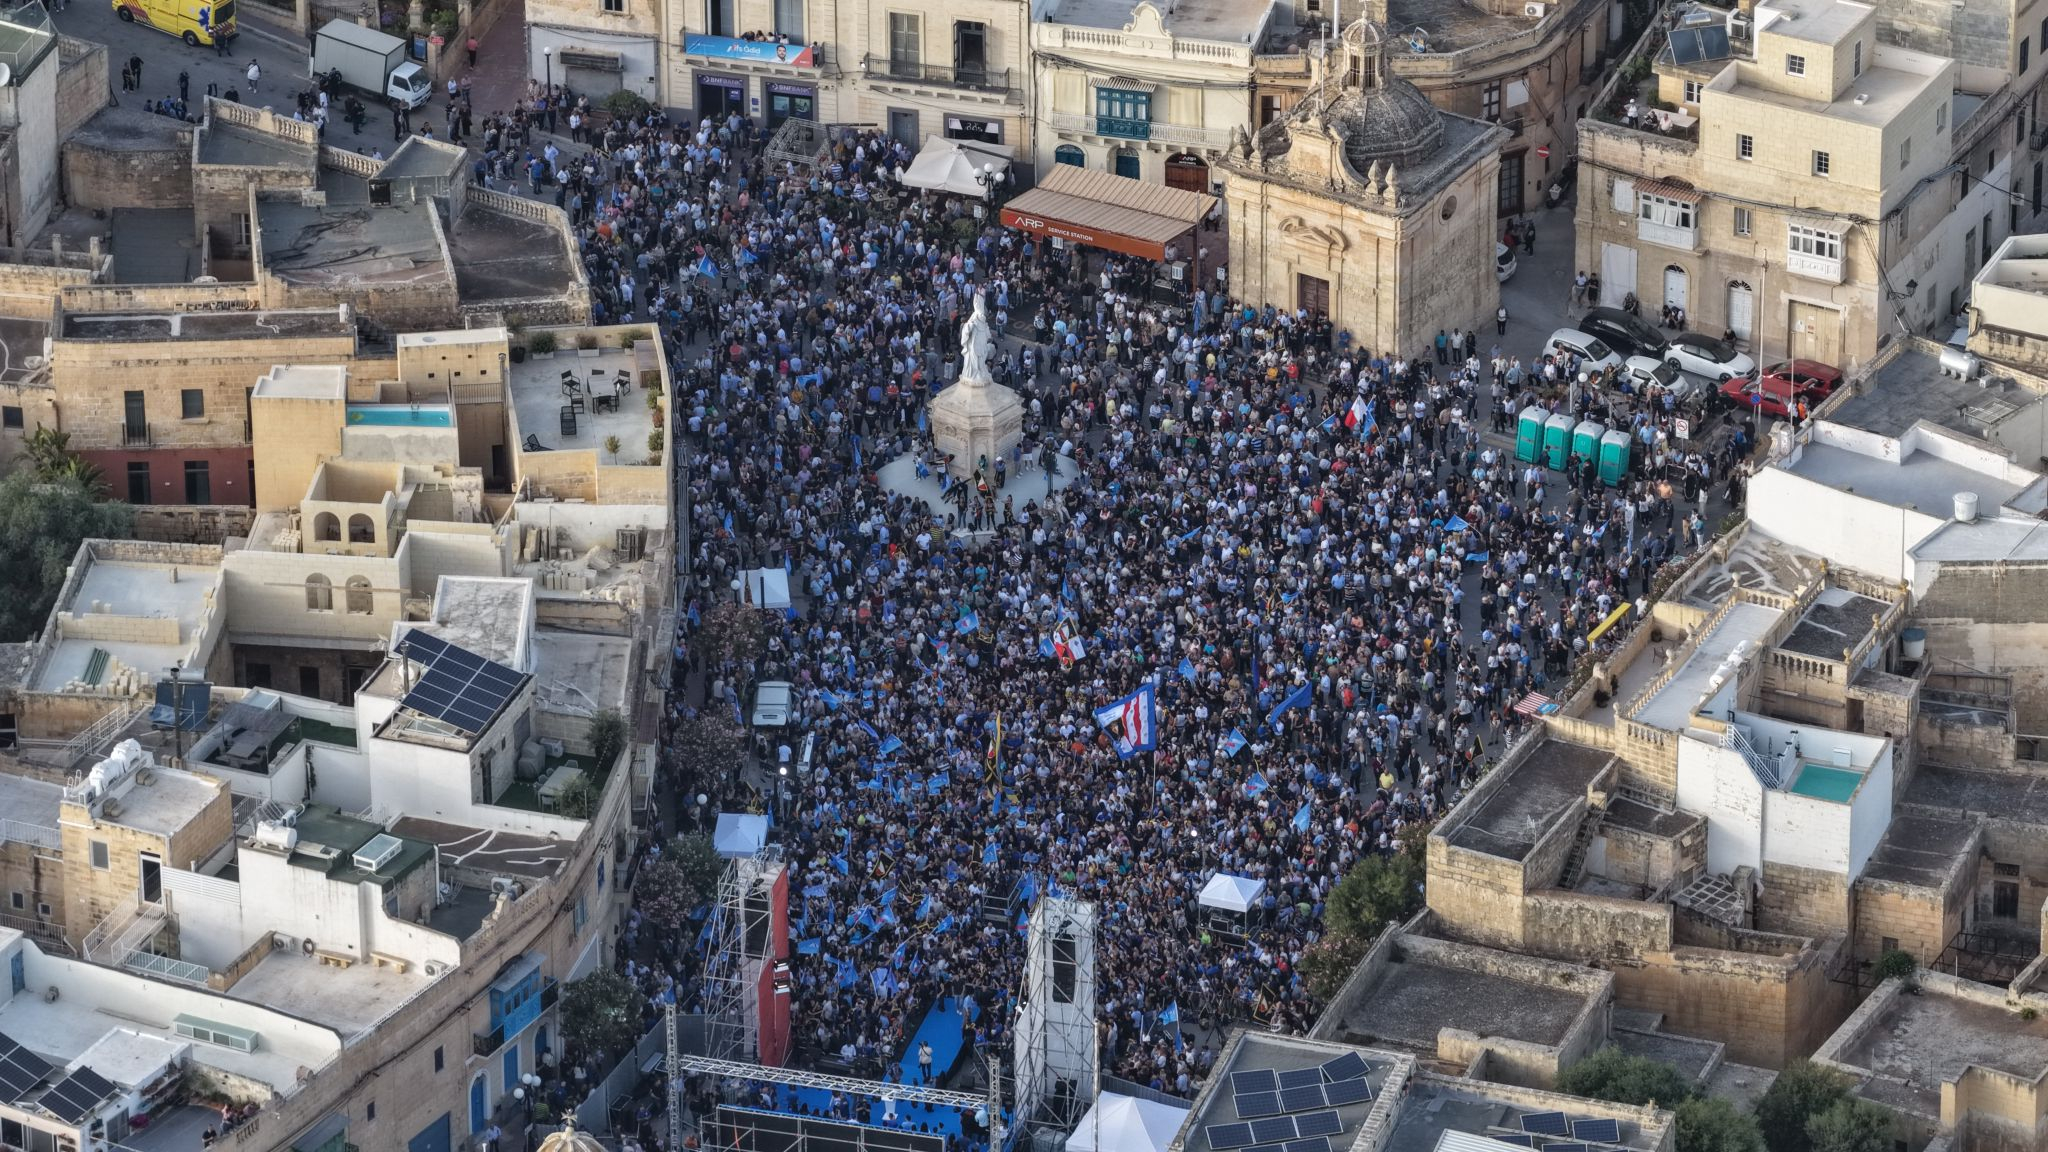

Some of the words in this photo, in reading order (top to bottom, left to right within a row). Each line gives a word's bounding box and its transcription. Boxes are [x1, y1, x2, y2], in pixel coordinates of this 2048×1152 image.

[1015, 216, 1044, 229] ARP
[1047, 226, 1070, 237] SERVICE
[1071, 232, 1093, 242] STATION
